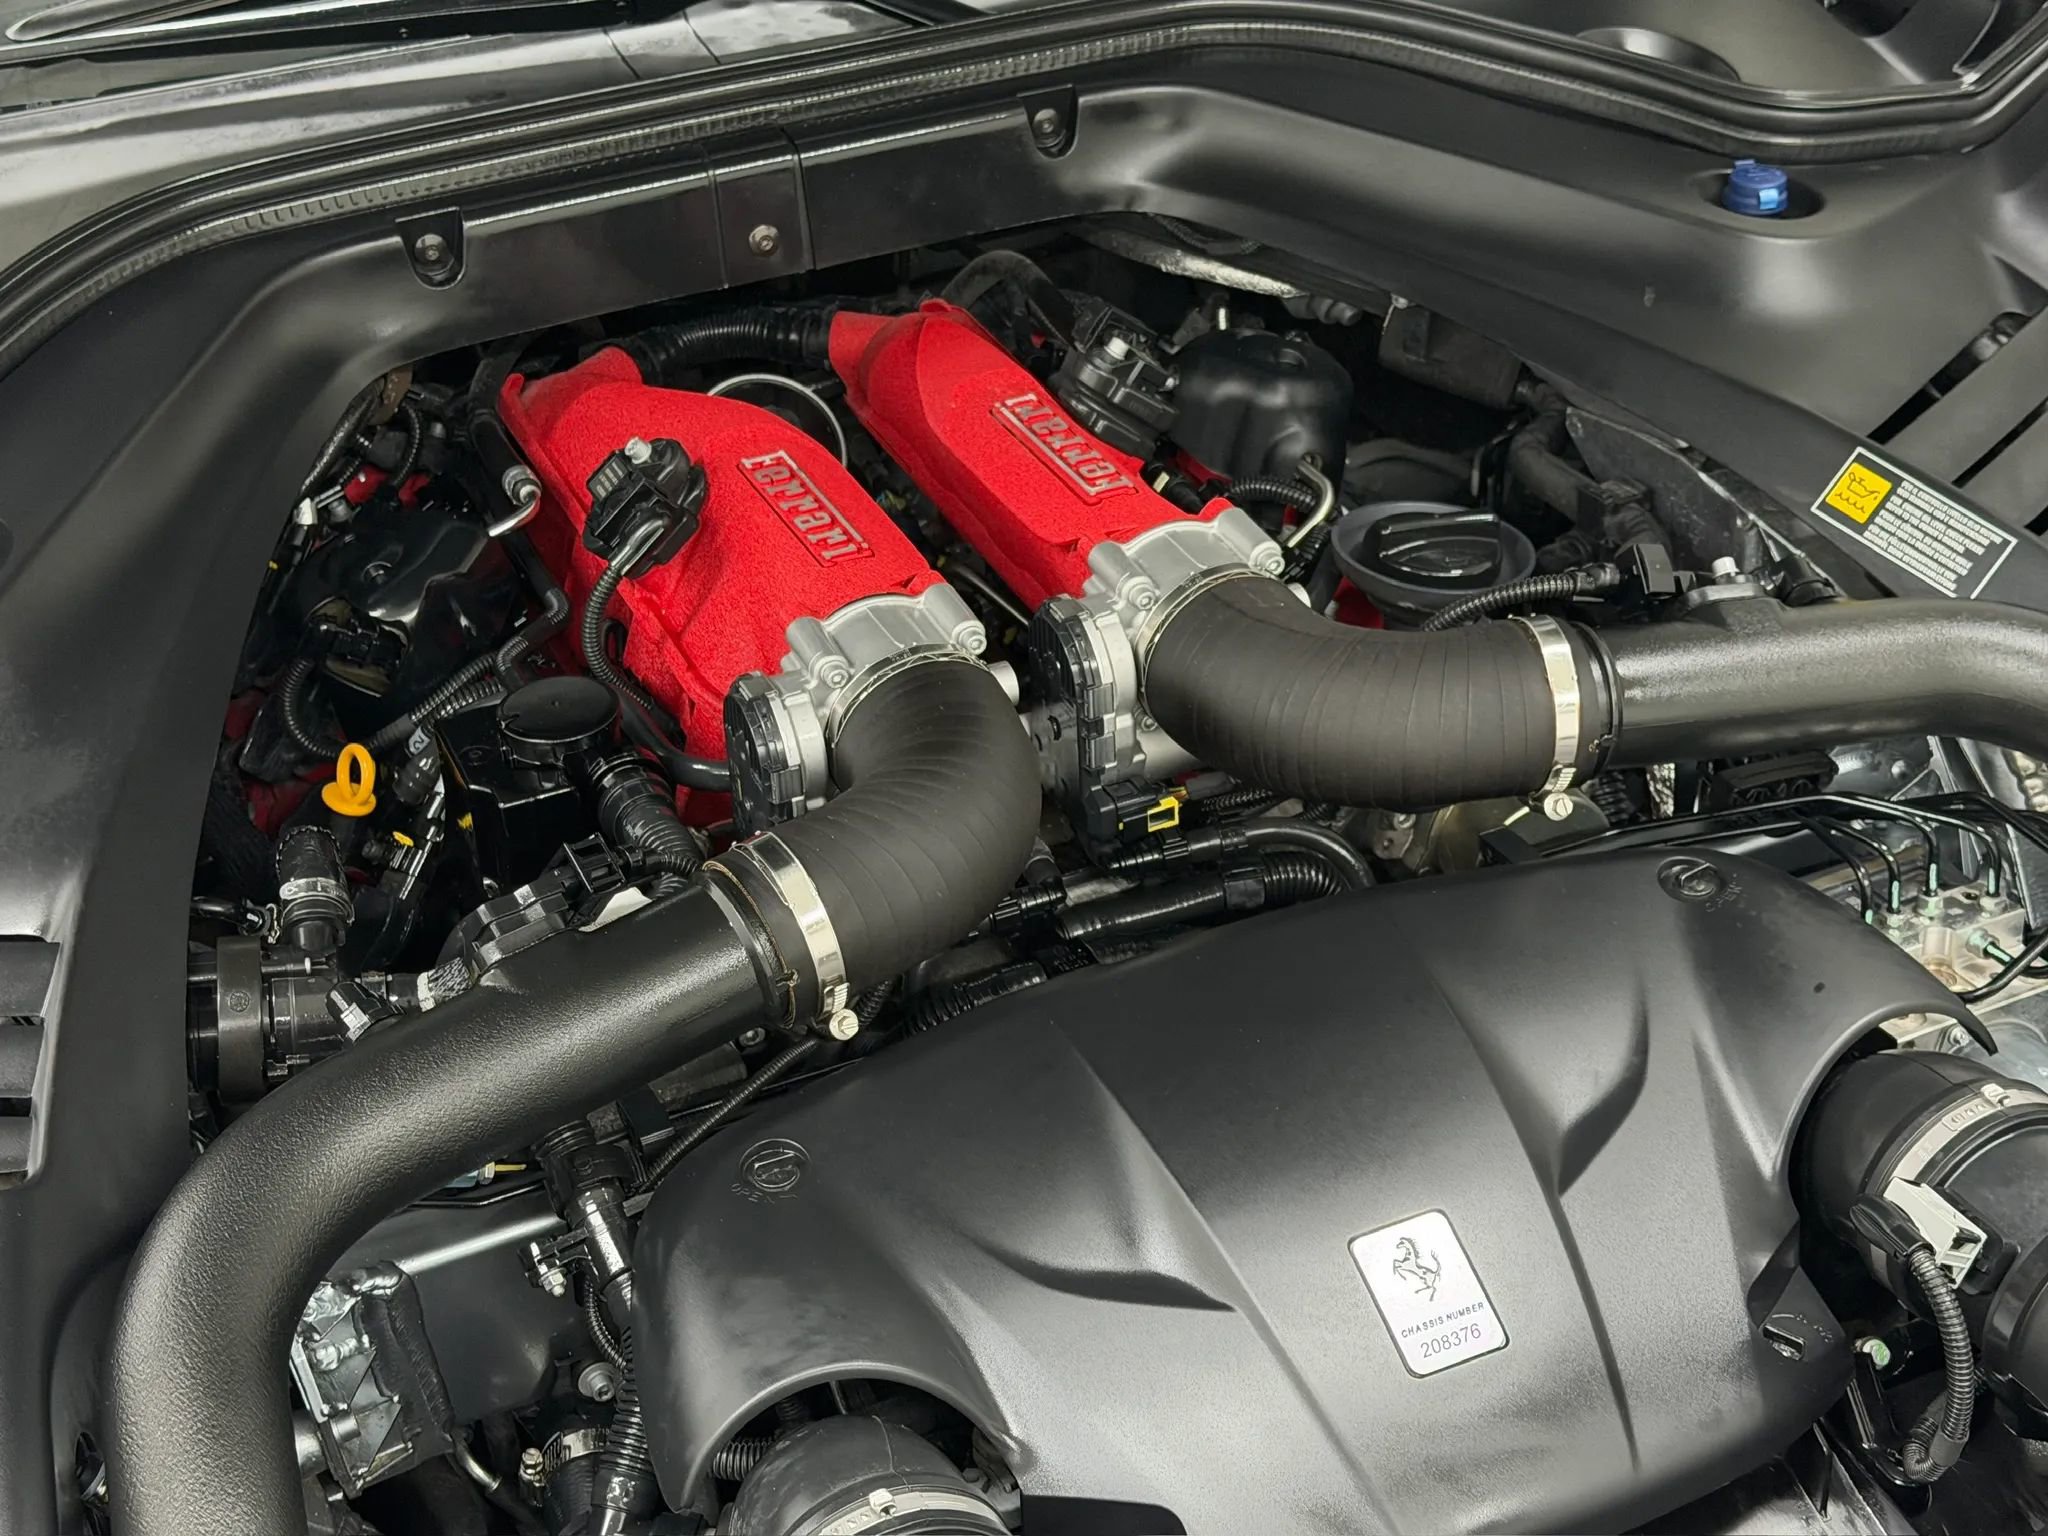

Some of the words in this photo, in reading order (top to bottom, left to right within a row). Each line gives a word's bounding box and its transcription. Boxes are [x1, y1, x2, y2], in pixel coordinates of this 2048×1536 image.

[993, 393, 1135, 496] Ferrari
[740, 449, 870, 560] Ferrari
[1401, 1316, 1445, 1338] CHASSIS
[1446, 1302, 1485, 1322] NUMBER
[1420, 1323, 1482, 1358] 208376
